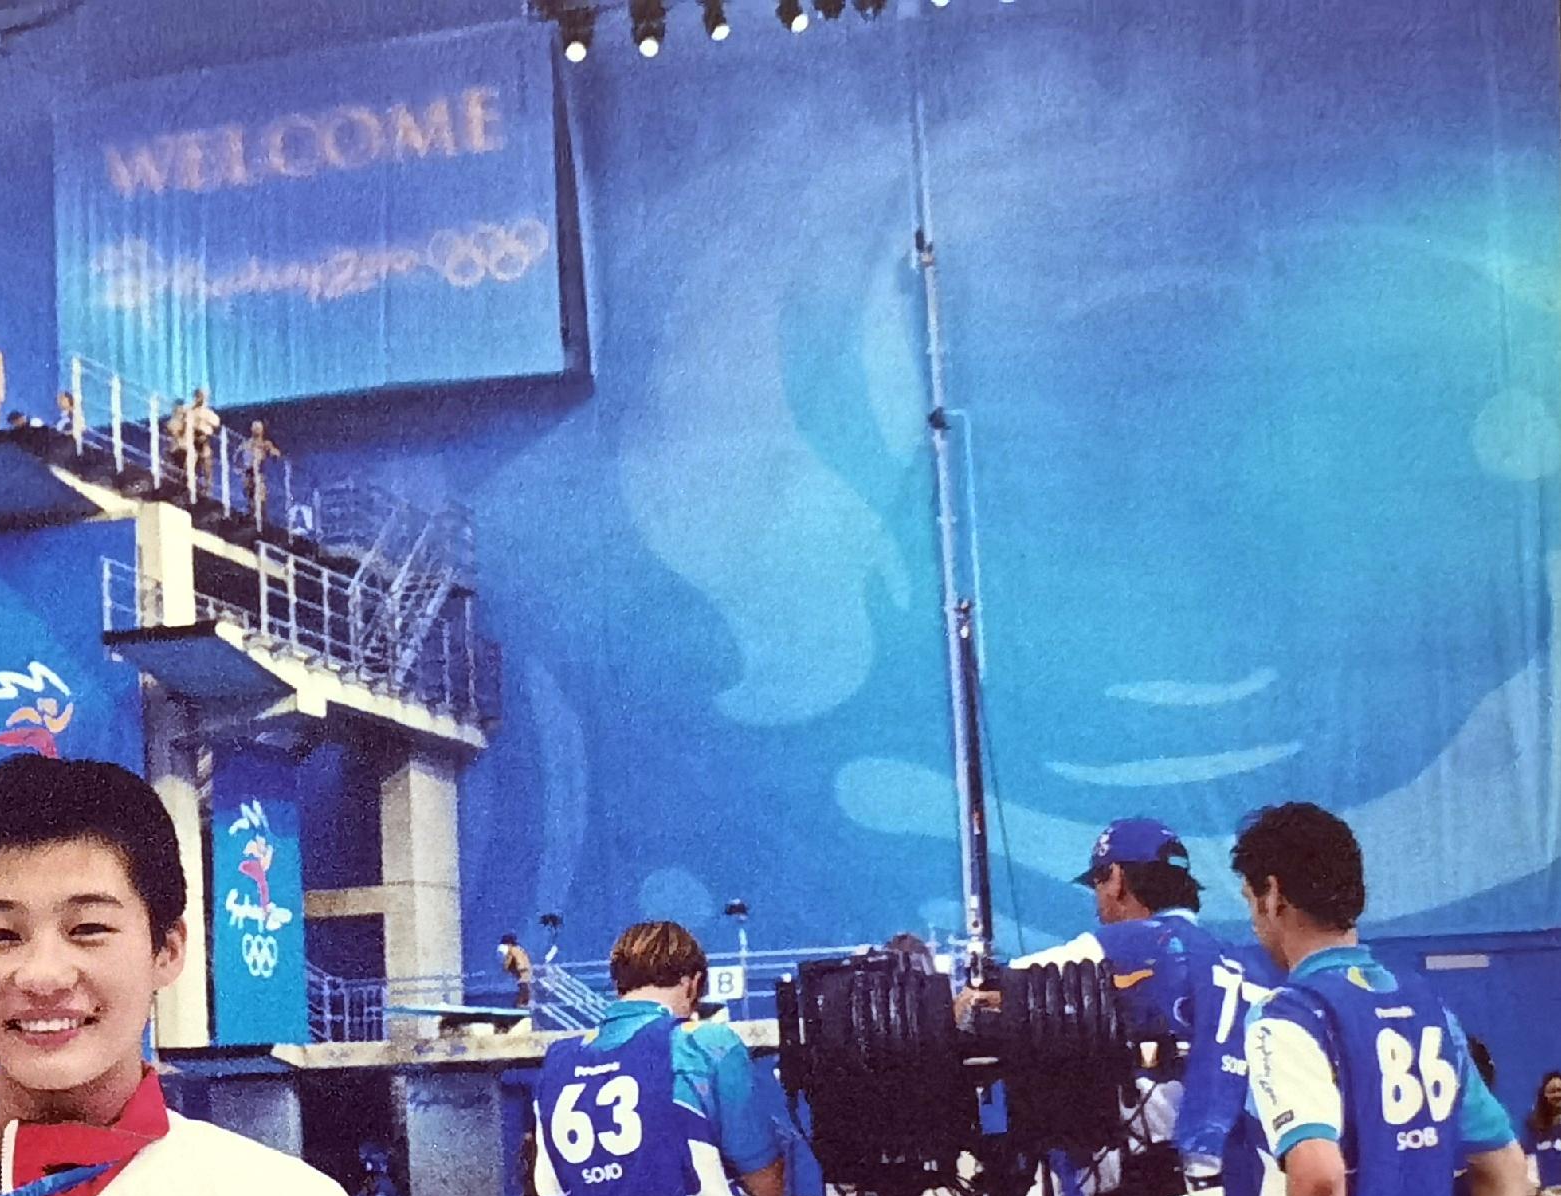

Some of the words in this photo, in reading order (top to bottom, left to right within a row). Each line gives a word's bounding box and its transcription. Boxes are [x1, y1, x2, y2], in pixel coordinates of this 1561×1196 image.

[106, 86, 505, 197] WELCOME
[551, 1075, 643, 1164] 63
[1376, 1026, 1458, 1125] 86
